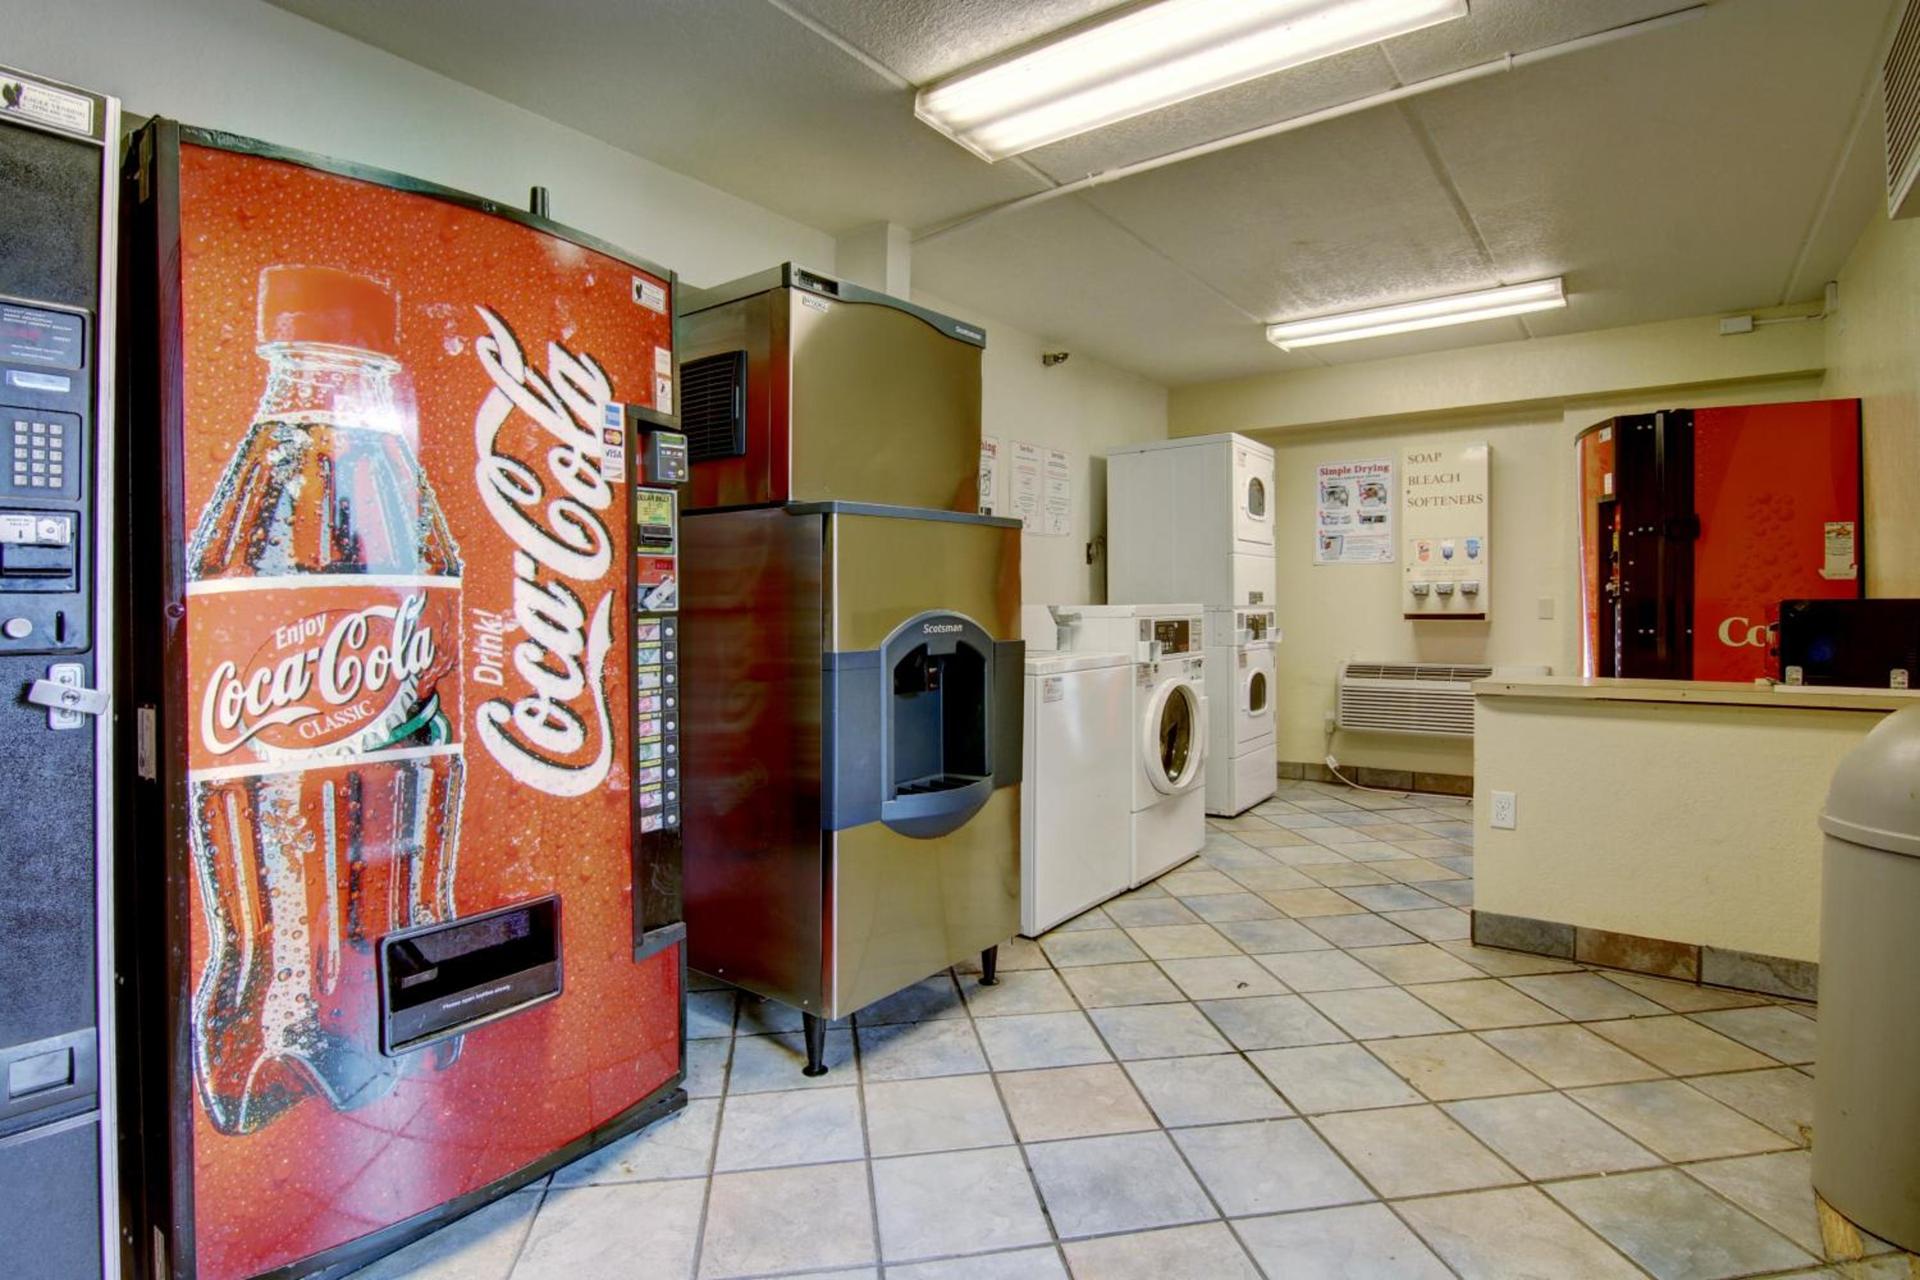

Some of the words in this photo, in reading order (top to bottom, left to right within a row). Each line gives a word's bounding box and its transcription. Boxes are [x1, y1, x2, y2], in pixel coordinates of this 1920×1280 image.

[1320, 465, 1352, 477] Simple
[1354, 463, 1390, 475] Drying
[1408, 452, 1442, 464] SOAP
[1408, 472, 1460, 486] BLEACH
[1407, 493, 1483, 507] SOFTENERS
[474, 304, 614, 798] Coca-Cola
[275, 612, 327, 649] Enjoy
[922, 623, 964, 634] Scotsman
[471, 607, 504, 687] Drink!
[201, 590, 436, 755] Coca-Cola
[299, 699, 376, 740] CLASSIC
